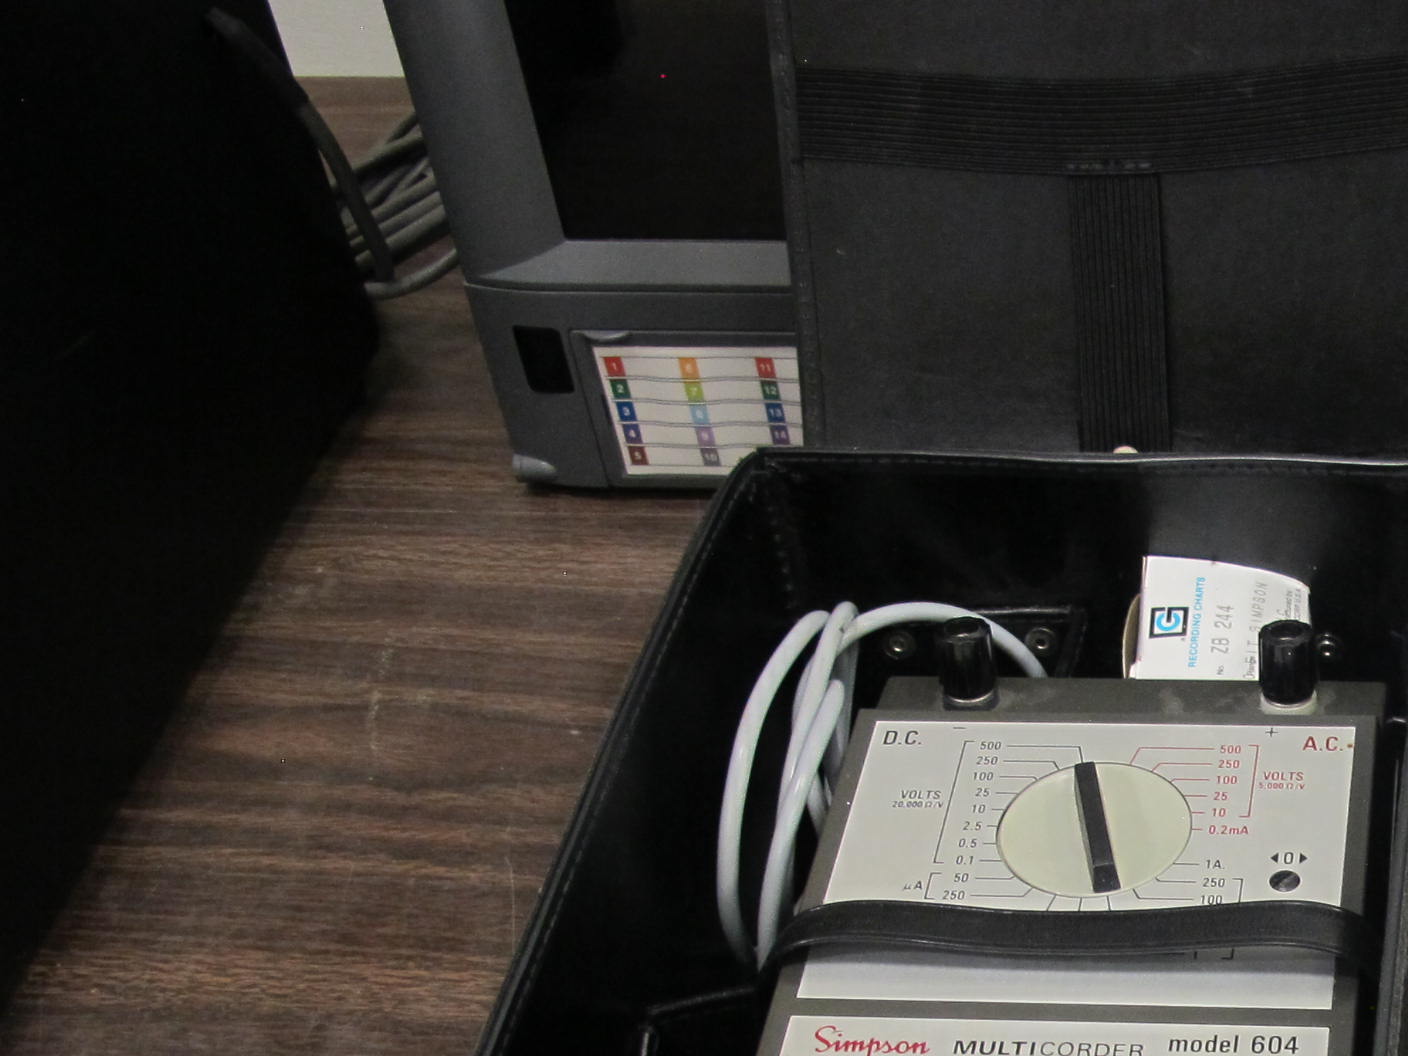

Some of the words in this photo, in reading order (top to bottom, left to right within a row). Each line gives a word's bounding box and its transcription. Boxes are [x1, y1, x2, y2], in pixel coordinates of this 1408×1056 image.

[1214, 604, 1235, 629] 244
[1187, 616, 1200, 668] RECORDING
[1194, 576, 1206, 614] CHARTS
[883, 730, 922, 746] D.C.
[979, 741, 1001, 750] 500
[1220, 745, 1242, 754] 500
[976, 756, 998, 766] 250
[1218, 760, 1240, 769] 250
[973, 772, 994, 781] 100
[1216, 776, 1238, 785] 100
[1263, 772, 1305, 782] VOLTS
[900, 790, 942, 800] VOLTS
[975, 788, 990, 797] 25
[1213, 792, 1228, 801] 25
[971, 804, 986, 814] 10
[1211, 808, 1226, 817] 10
[963, 821, 982, 831] 2.5
[1208, 825, 1249, 835] 0.2mA
[958, 838, 977, 848] 0.5
[956, 856, 974, 866] 0.1
[953, 873, 969, 883] 50
[1202, 878, 1226, 888] 250
[943, 890, 966, 901] 250
[1200, 895, 1223, 905] 100
[1167, 1034, 1240, 1054] model
[1251, 1036, 1299, 1056] 604
